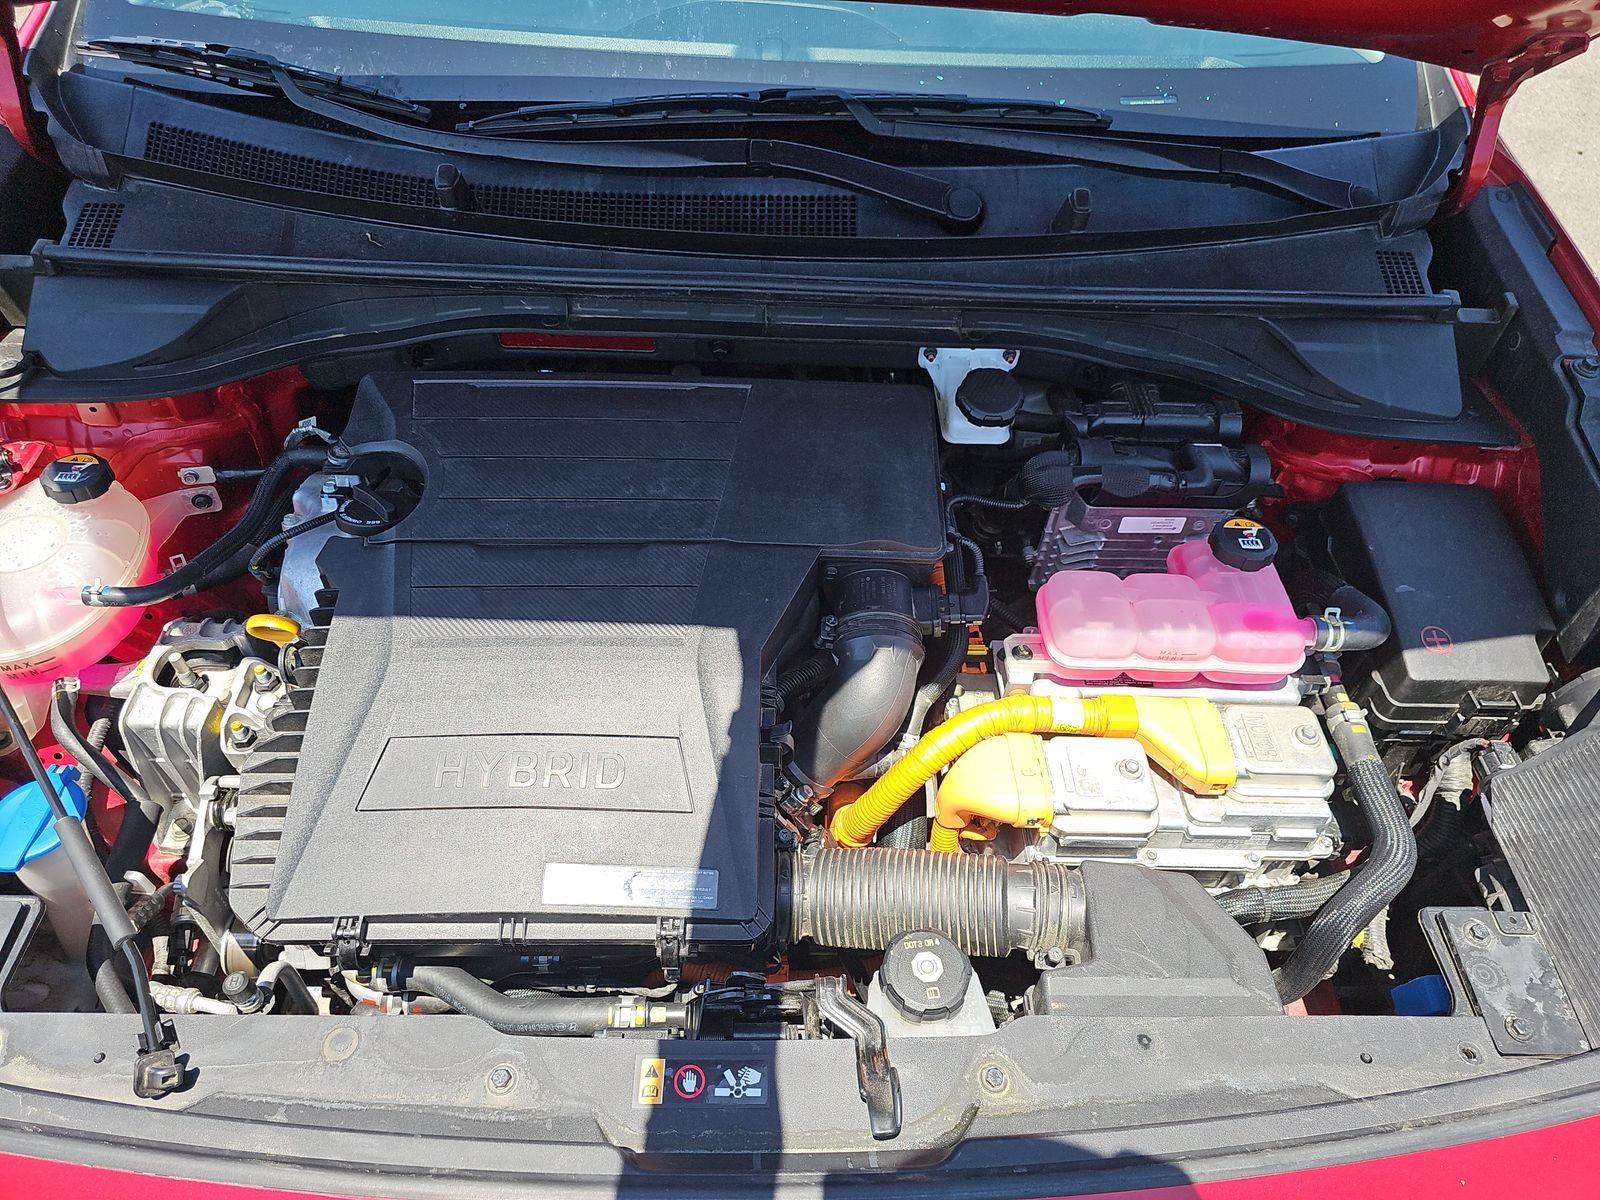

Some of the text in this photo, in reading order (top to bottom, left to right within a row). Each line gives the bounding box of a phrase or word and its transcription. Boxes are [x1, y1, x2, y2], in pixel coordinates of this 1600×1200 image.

[0, 661, 33, 672] MAX
[6, 669, 40, 680] MIN
[433, 750, 627, 790] HYBRID
[229, 975, 240, 987] H
